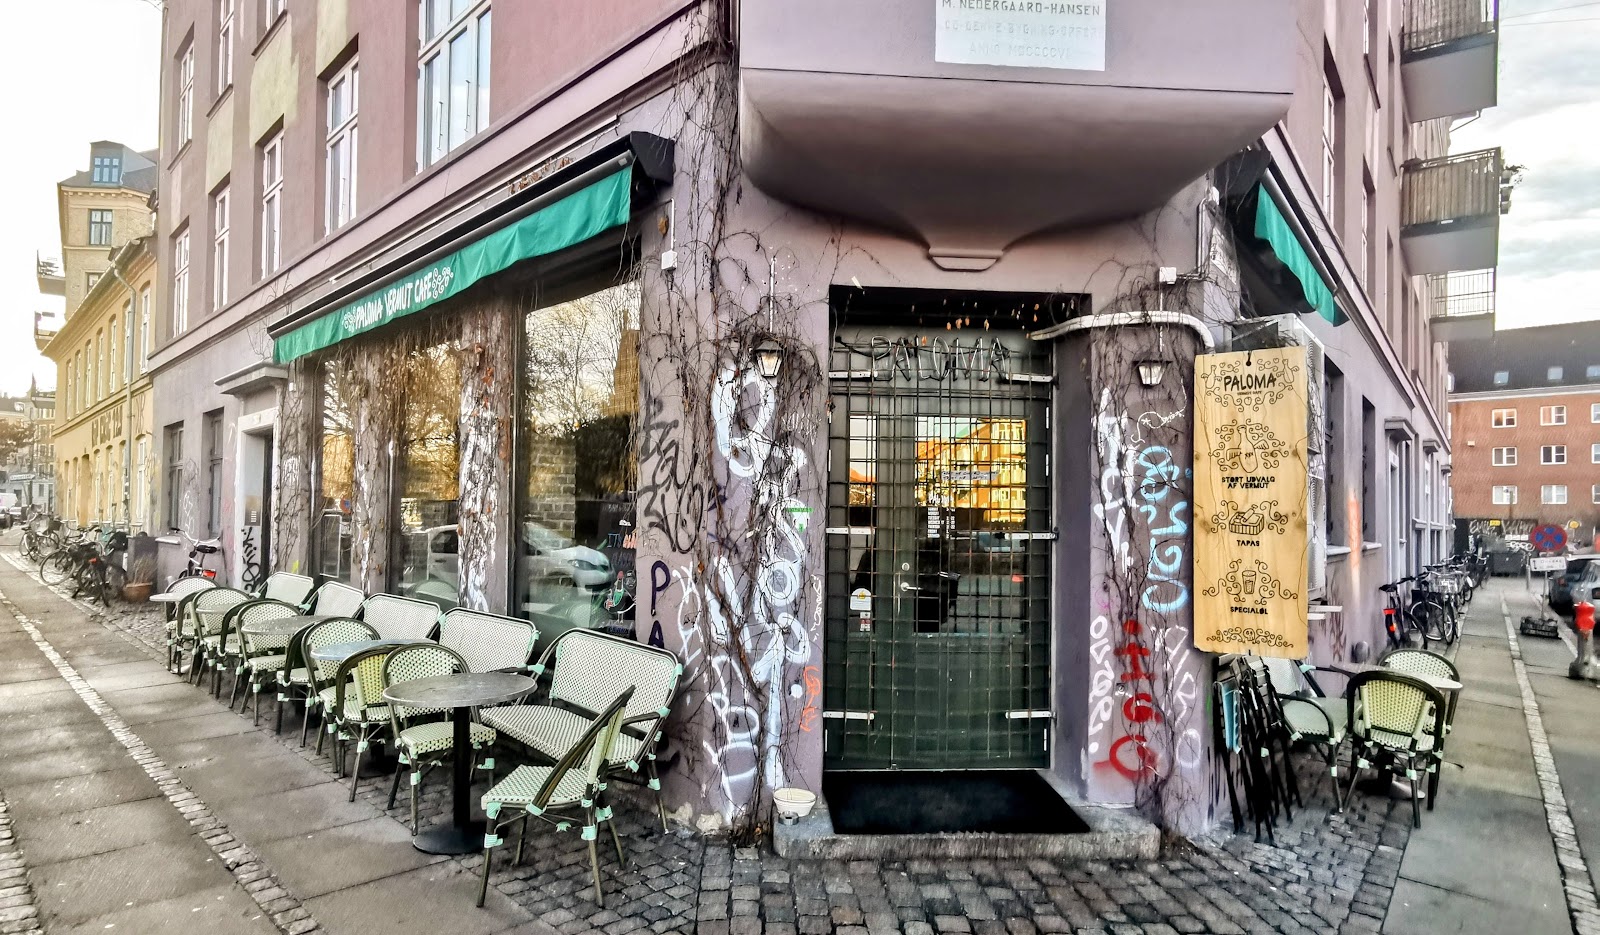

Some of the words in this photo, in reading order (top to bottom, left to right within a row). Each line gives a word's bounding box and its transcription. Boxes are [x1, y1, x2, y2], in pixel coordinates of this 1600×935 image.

[355, 298, 383, 330] PALOMA
[384, 282, 414, 317] VERMUT
[414, 271, 432, 304] CAFE
[1223, 373, 1277, 392] PALOMA
[1236, 539, 1260, 547] TAPAS
[1230, 606, 1269, 615] SPECIALØL
